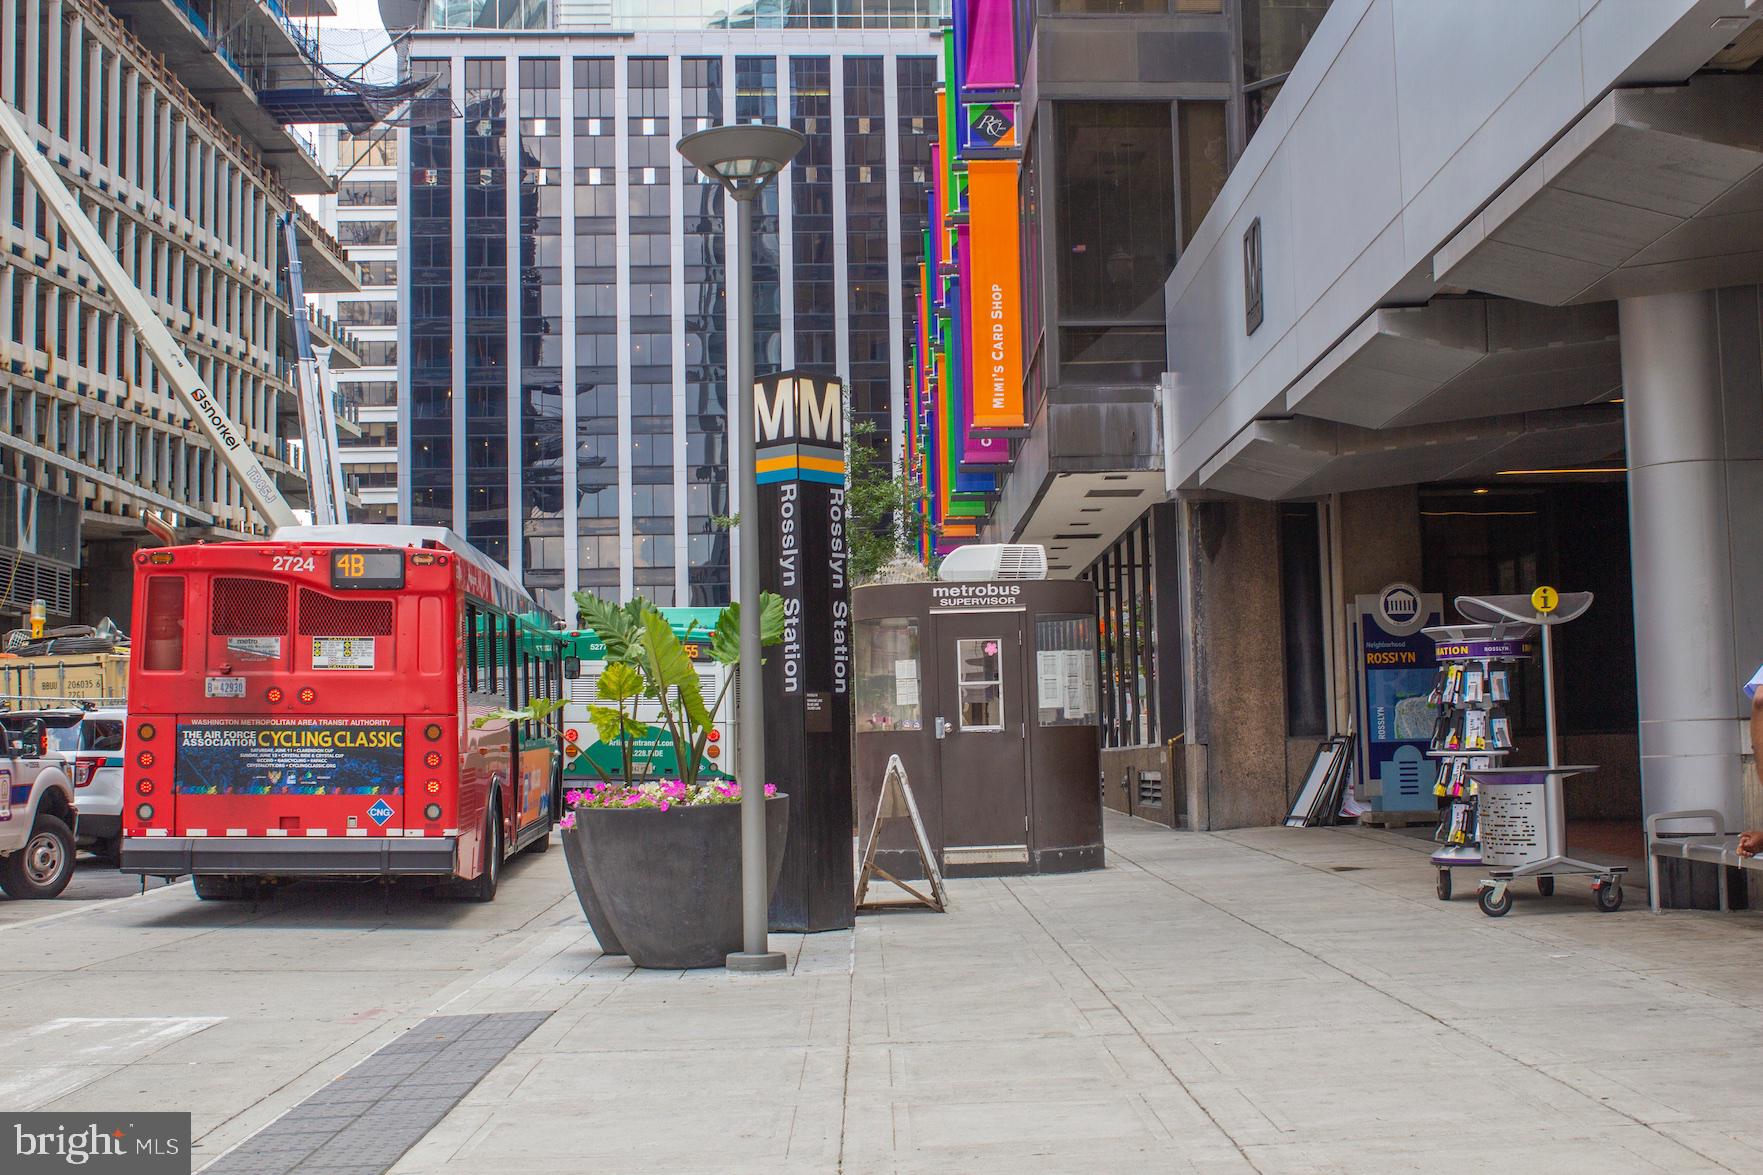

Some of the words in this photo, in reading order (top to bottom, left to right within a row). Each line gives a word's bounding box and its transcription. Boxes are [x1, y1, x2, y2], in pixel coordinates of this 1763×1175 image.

[992, 284, 1003, 319] SHOP
[992, 324, 1004, 361] CARD
[992, 365, 1005, 408] MIMI'S
[754, 377, 794, 443] M
[800, 377, 842, 443] M
[200, 400, 240, 450] snorkel
[780, 484, 798, 586] Rosslyn
[828, 488, 846, 588] Rosslyn
[272, 556, 315, 572] 2724
[336, 554, 365, 576] 4B
[932, 584, 1020, 597] metrobus
[940, 596, 1016, 606] SUPERVISOR
[784, 598, 800, 692] Station
[832, 600, 848, 693] Station
[1366, 641, 1406, 650] Neighborhood
[1367, 651, 1416, 664] ROSSLYN
[182, 731, 204, 739] THE
[205, 731, 221, 739] AIR
[223, 731, 256, 739] FORCE
[182, 738, 257, 747] ASSOCIATION
[258, 731, 332, 747] CYCLING
[334, 731, 402, 747] CLASSIC
[370, 808, 390, 816] CNG
